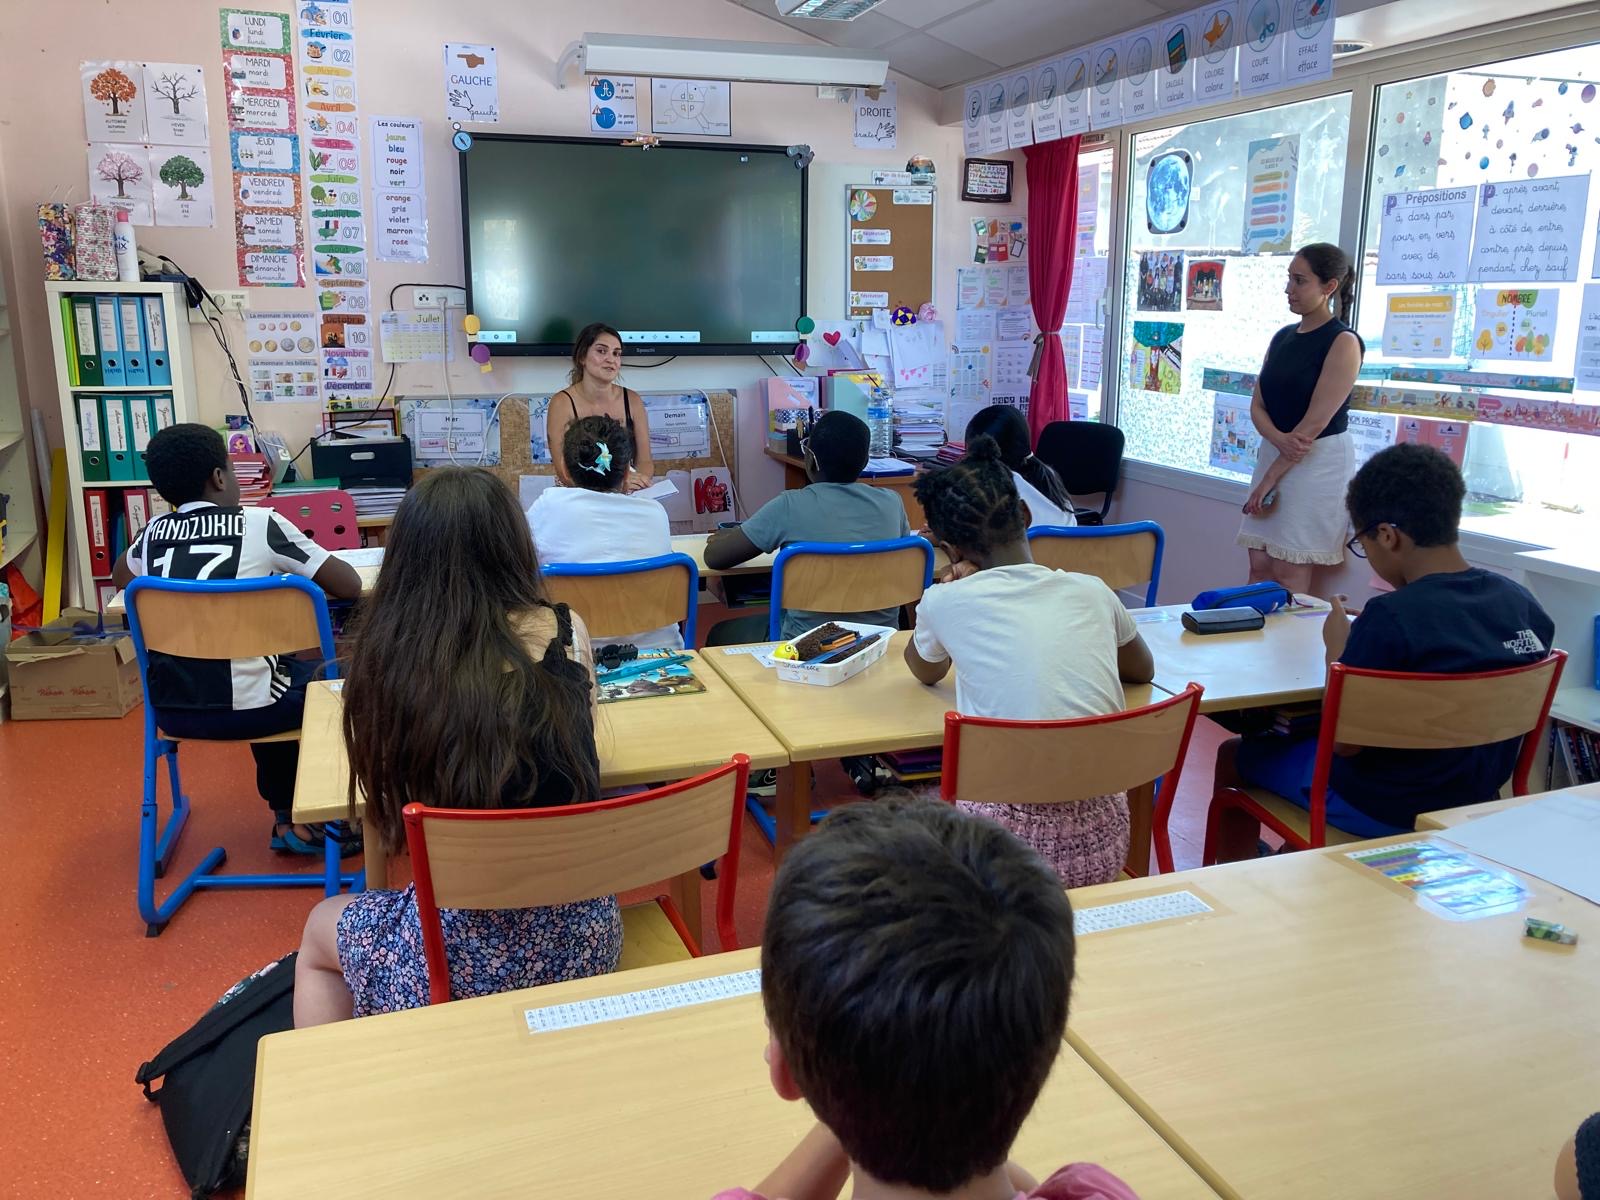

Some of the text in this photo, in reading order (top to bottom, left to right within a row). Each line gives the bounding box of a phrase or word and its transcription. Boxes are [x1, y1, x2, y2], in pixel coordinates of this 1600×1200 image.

[244, 16, 266, 27] LUNDI
[332, 10, 349, 25] 01
[247, 27, 264, 36] lundi
[309, 29, 344, 41] Février
[1298, 43, 1318, 56] EFFACE
[333, 48, 351, 63] 02
[245, 58, 271, 68] MARDI
[1251, 56, 1269, 68] COUPE
[1297, 59, 1318, 73] efface
[248, 69, 269, 77] mardi
[317, 67, 341, 76] Mars
[1204, 67, 1225, 80] COLORIE
[450, 74, 493, 87] GAUCHE
[1165, 78, 1184, 88] CALCULE
[1251, 72, 1270, 84] coupe
[335, 86, 353, 99] 03
[1204, 82, 1224, 93] colorie
[680, 92, 694, 100] d b
[1133, 90, 1144, 98] POSE
[1166, 93, 1185, 103] calcule
[242, 97, 280, 109] MERCREDI
[320, 102, 341, 112] Avril
[680, 104, 695, 112] q p
[1133, 103, 1145, 112] pose
[246, 108, 278, 118] mercredi
[469, 105, 498, 121] gauche
[860, 107, 892, 117] DROITE
[336, 121, 355, 134] 04
[377, 120, 415, 130] Les couleurs
[256, 137, 275, 146] JEUDI
[385, 133, 407, 142] jaune
[257, 147, 273, 157] jeudi
[388, 144, 405, 154] bleu
[338, 157, 357, 171] 05
[386, 156, 408, 167] rouge
[389, 167, 405, 176] noir
[249, 177, 285, 188] VENDREDI
[324, 174, 345, 183] Juin
[389, 179, 406, 187] vert
[252, 188, 282, 197] vendredi
[340, 191, 359, 205] 06
[385, 194, 412, 203] orange
[1406, 190, 1467, 206] Prépositions
[323, 209, 352, 218] Juillet
[391, 205, 407, 214] gris
[255, 216, 283, 226] SAMEDI
[388, 216, 410, 225] violet
[258, 227, 280, 235] samedi
[342, 226, 360, 239] 07
[386, 227, 414, 236] marron
[1489, 224, 1496, 234] à
[1499, 223, 1518, 234] côté
[391, 238, 409, 246] rose
[250, 254, 288, 264] DIMANCHE
[254, 265, 286, 273] dimanche
[345, 261, 362, 274] 08
[1545, 255, 1569, 281] sauf
[1437, 270, 1456, 280] sur
[321, 279, 364, 288] Septembre
[348, 296, 366, 309] 09
[1501, 292, 1533, 304] NOMBRE
[415, 313, 440, 324] Juillet
[1525, 309, 1549, 318] Pluriel
[325, 314, 365, 325] Octobre
[351, 331, 367, 344] 10
[323, 348, 369, 358] Novembre
[355, 364, 367, 377] 11
[324, 380, 372, 391] Décembre
[1361, 416, 1382, 429] PROPRE
[153, 544, 234, 580] 17
[1516, 630, 1532, 639] THE
[1503, 638, 1535, 649] NORTH
[1514, 646, 1537, 655] FACE
